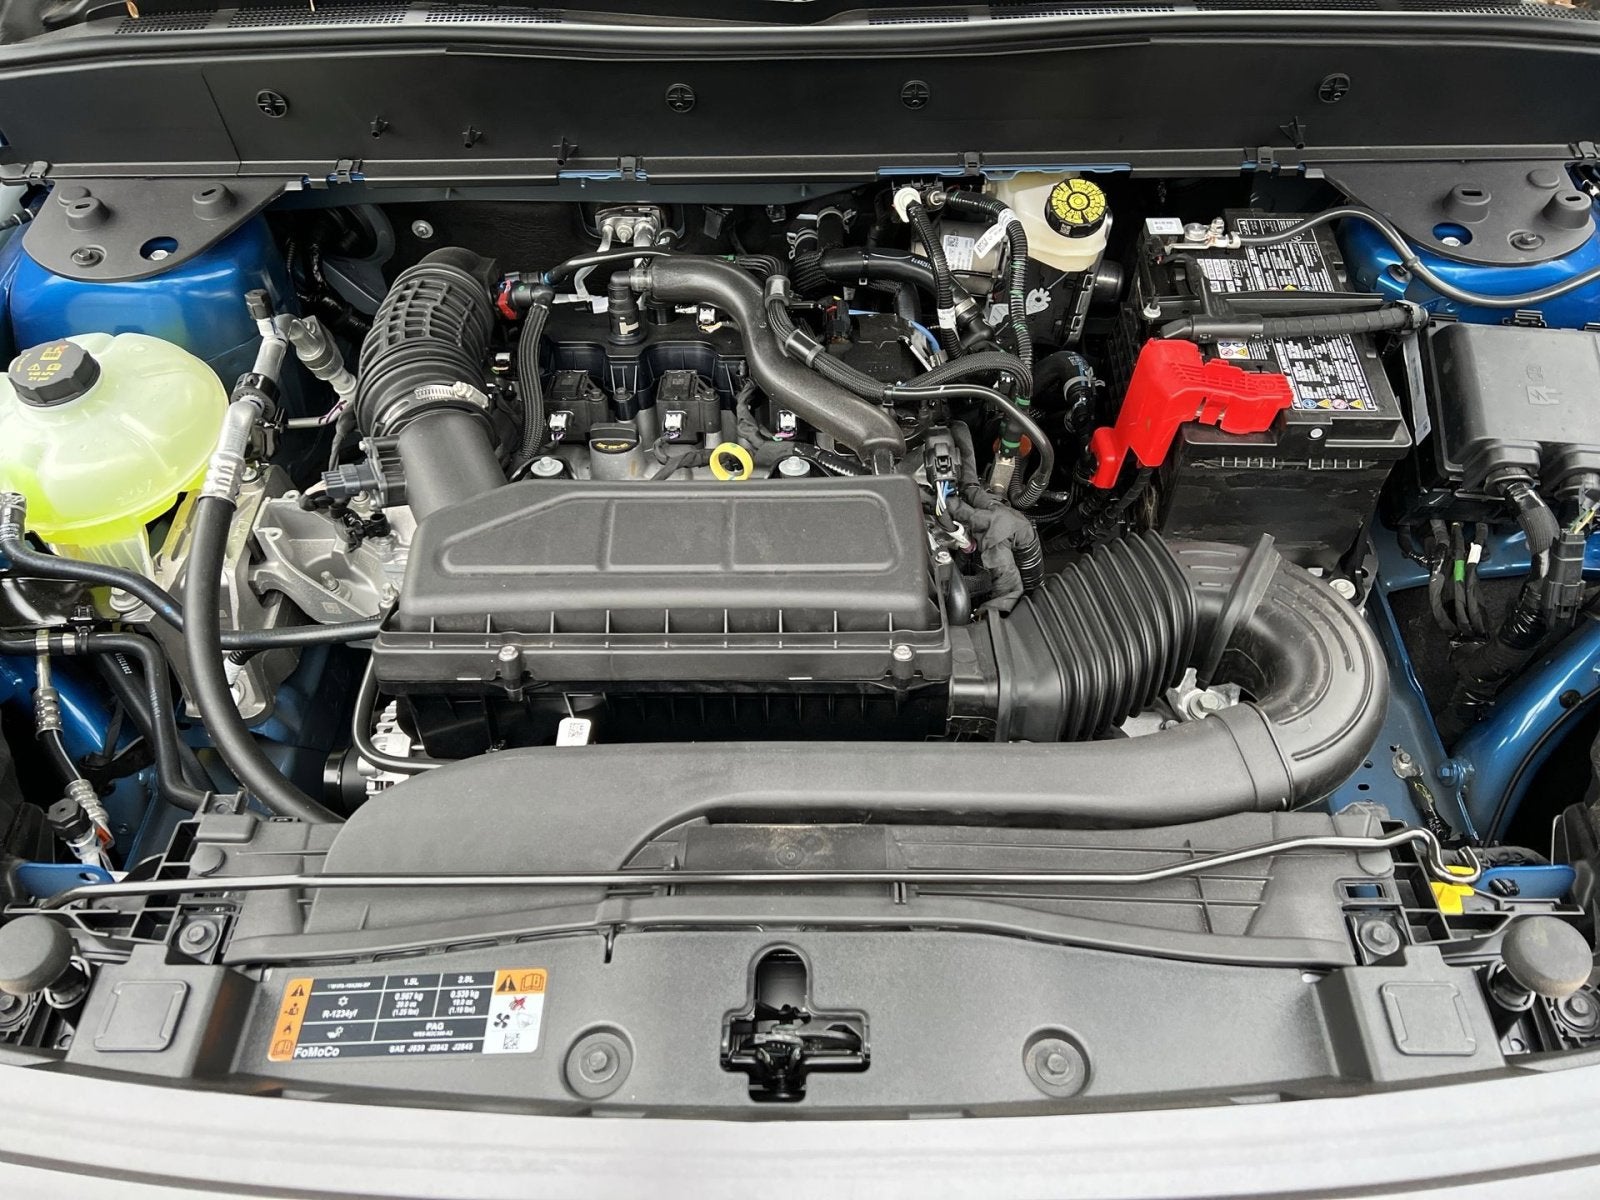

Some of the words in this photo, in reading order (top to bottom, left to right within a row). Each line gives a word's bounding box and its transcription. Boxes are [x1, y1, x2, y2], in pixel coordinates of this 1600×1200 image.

[469, 989, 480, 1000] kg
[322, 1008, 358, 1019] R-1234yf
[425, 1022, 445, 1031] PAG
[293, 1046, 340, 1058] FoMoCo
[388, 1045, 406, 1053] SAE
